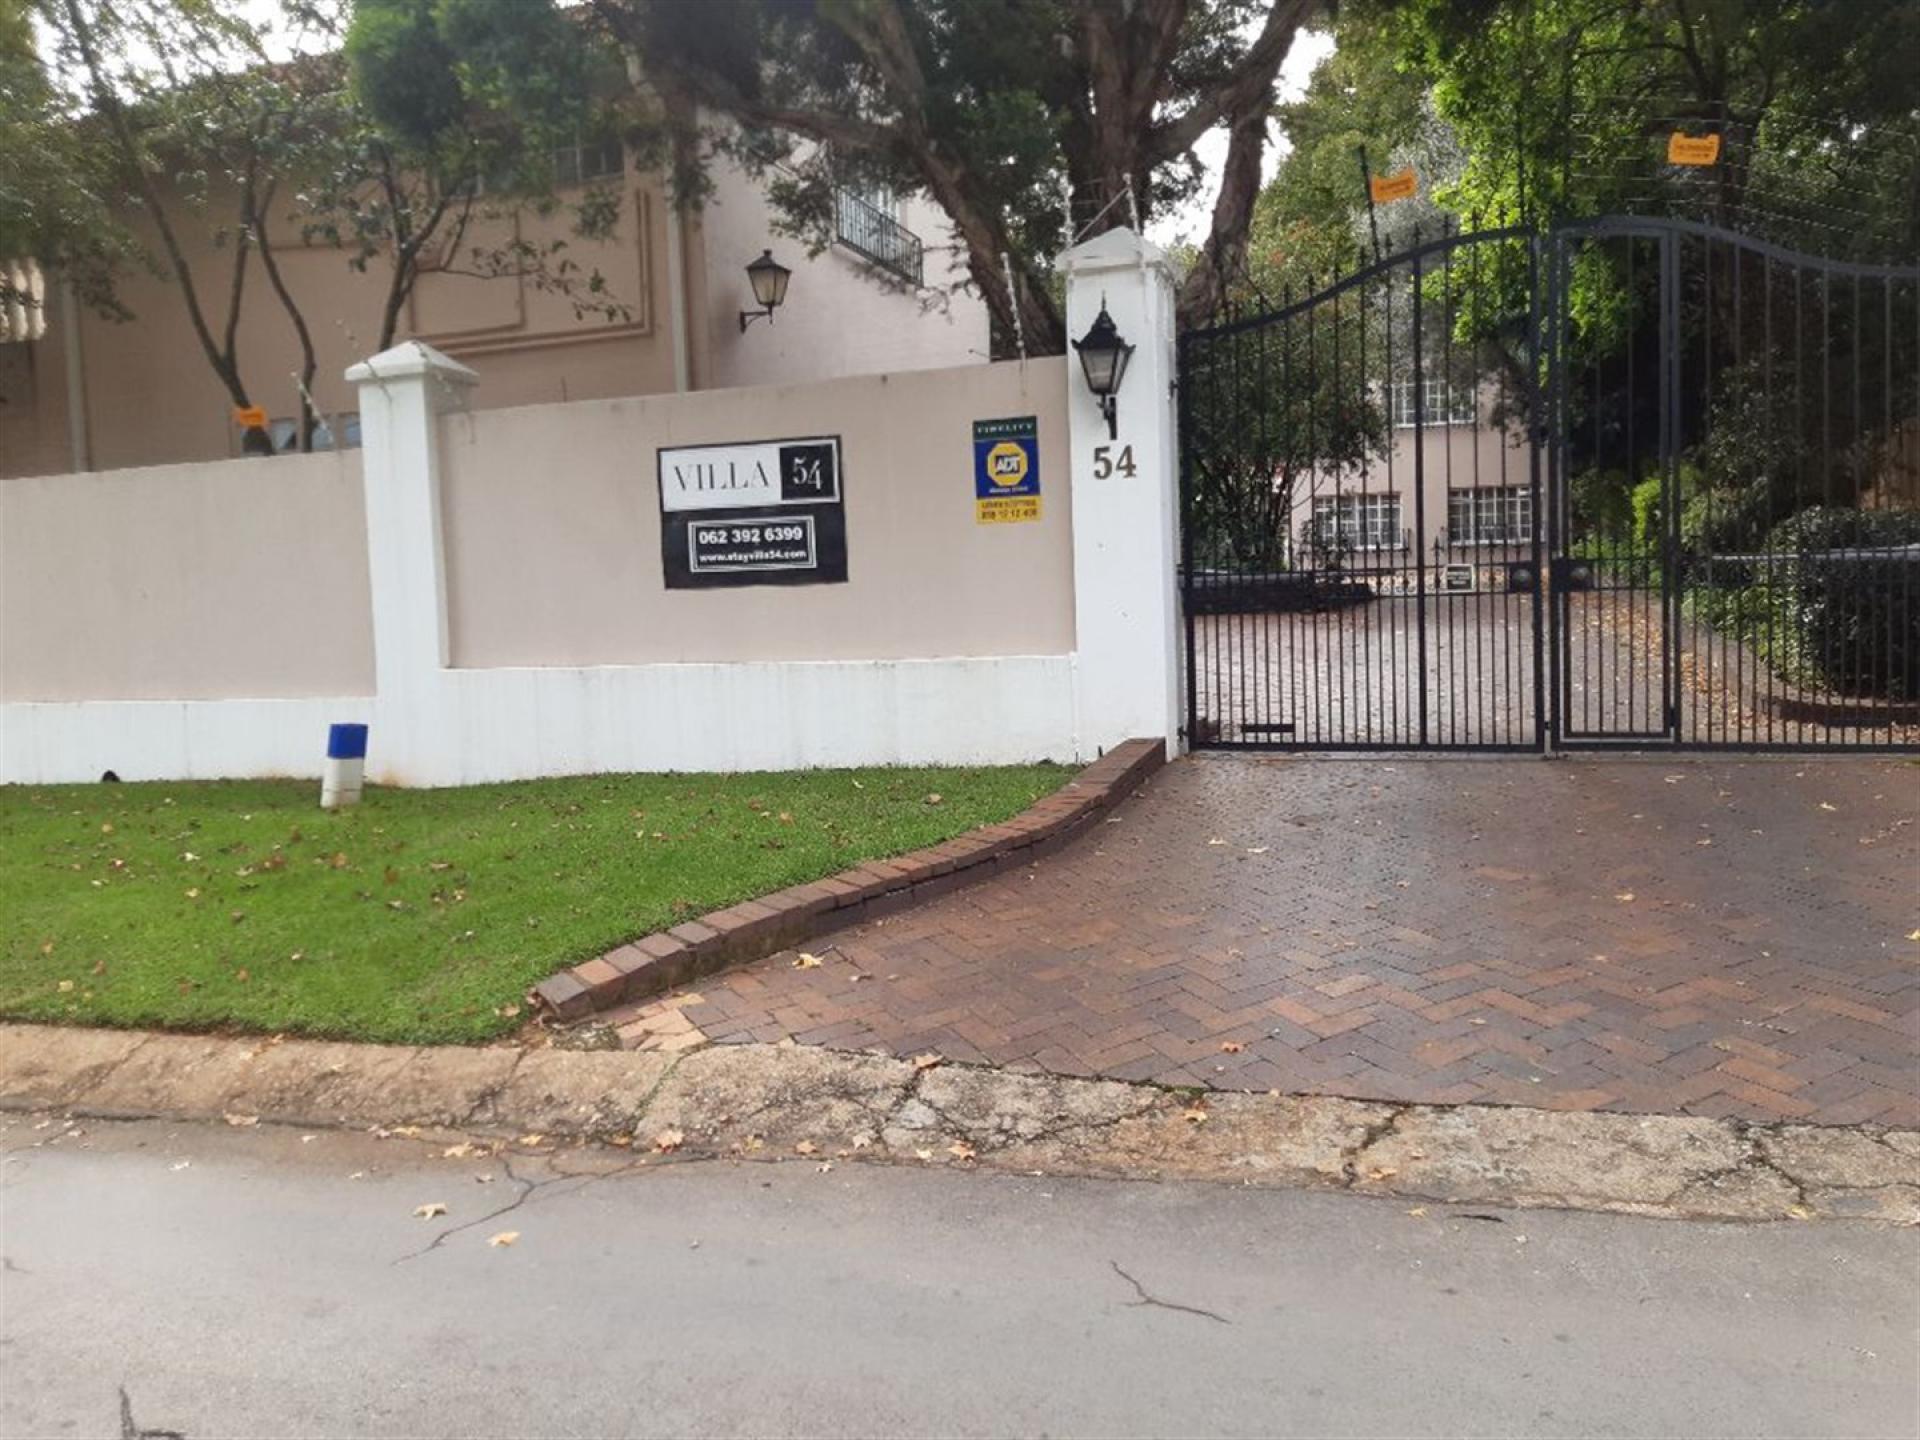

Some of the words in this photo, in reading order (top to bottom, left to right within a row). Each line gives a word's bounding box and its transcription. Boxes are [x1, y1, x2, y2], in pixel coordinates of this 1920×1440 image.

[674, 460, 769, 491] VILLA
[792, 455, 824, 490] 54
[995, 456, 1021, 475] ADT
[1093, 444, 1136, 480] 54
[699, 529, 728, 545] 062
[731, 528, 761, 544] 392
[764, 526, 803, 542] 6399
